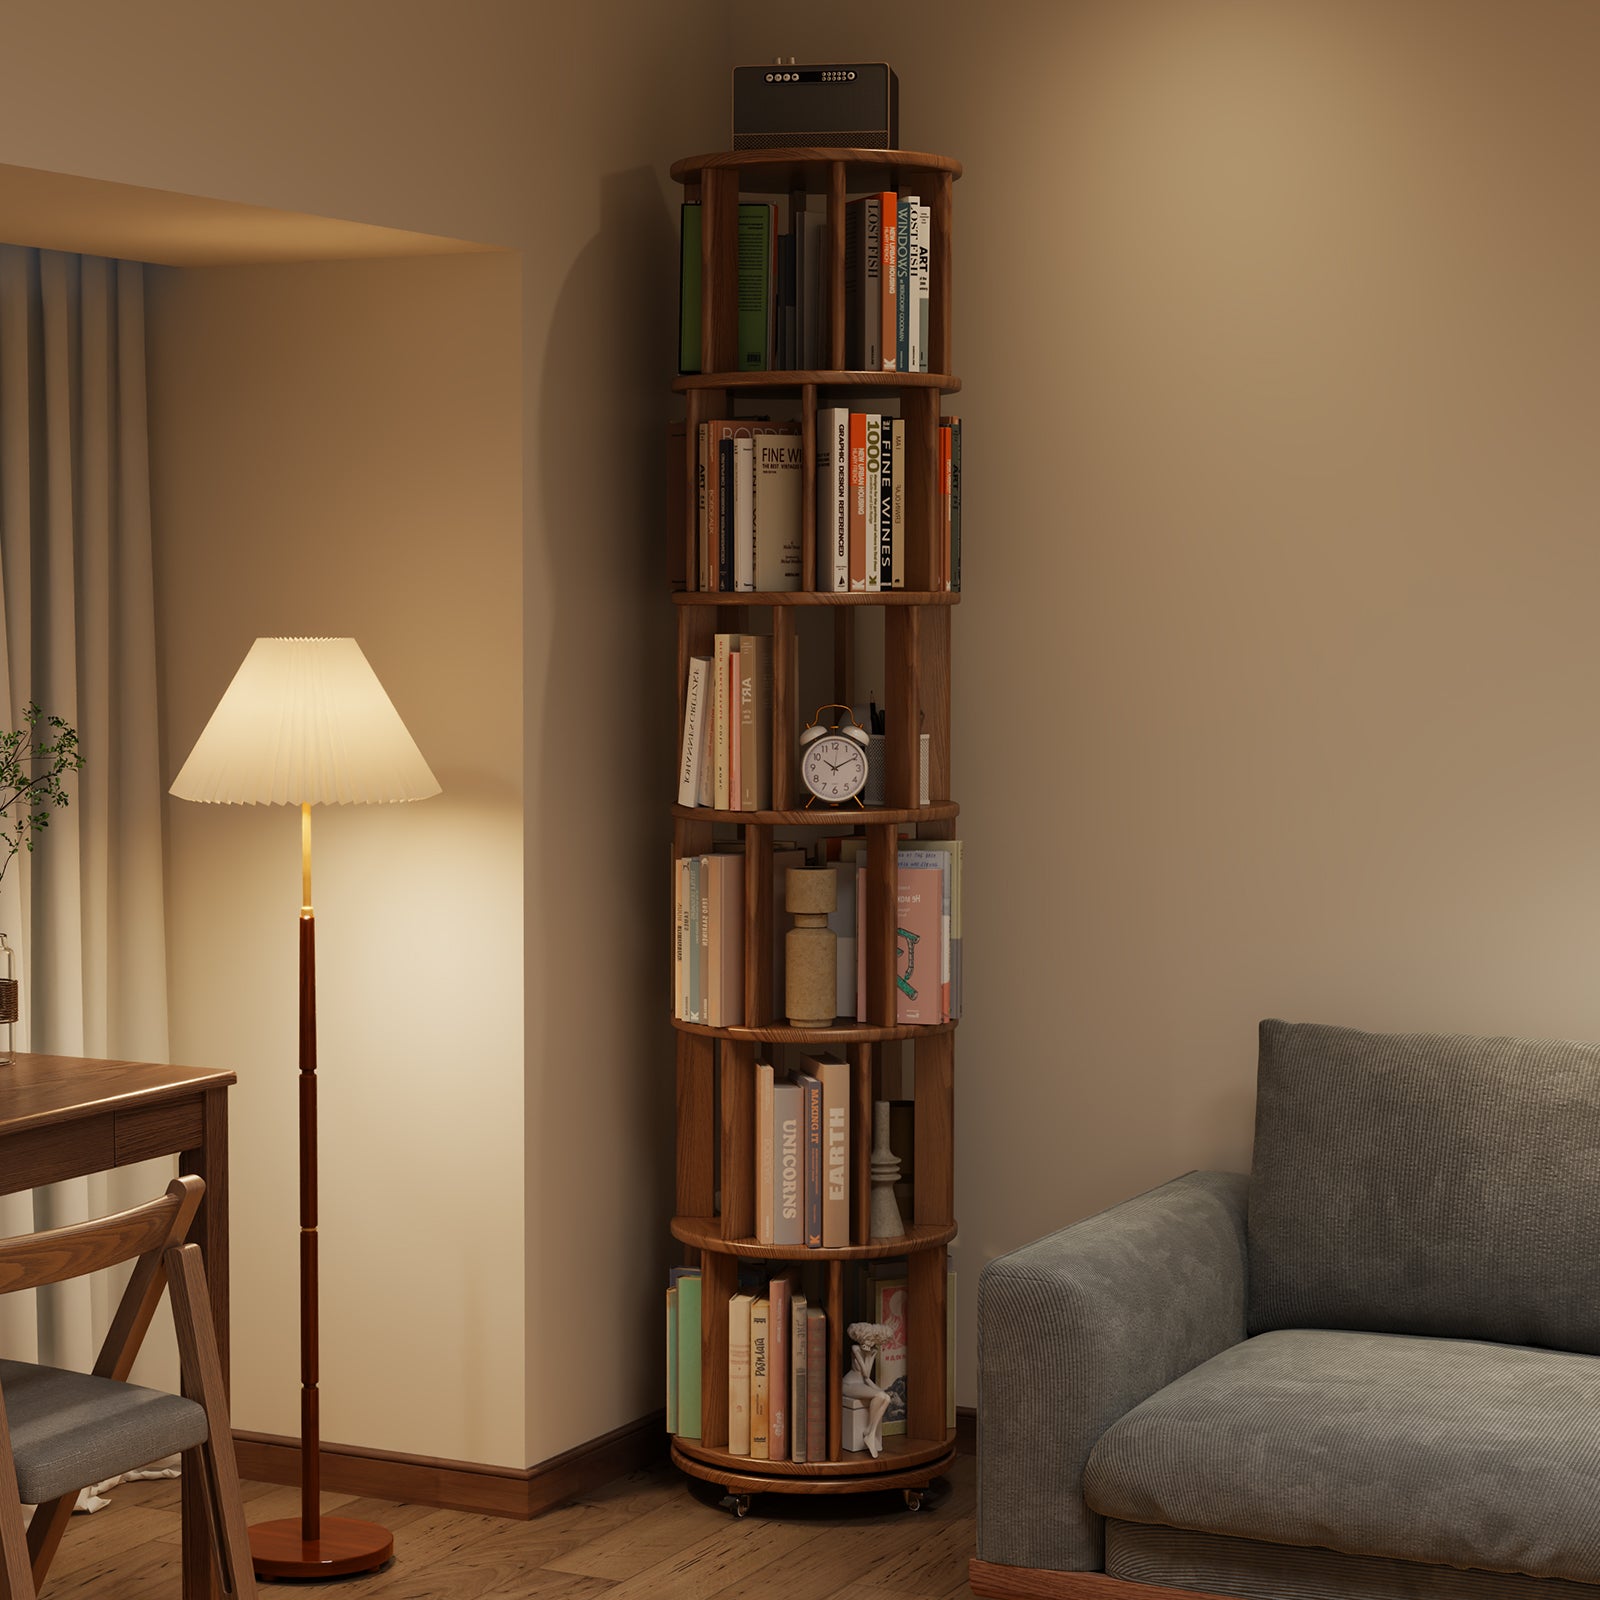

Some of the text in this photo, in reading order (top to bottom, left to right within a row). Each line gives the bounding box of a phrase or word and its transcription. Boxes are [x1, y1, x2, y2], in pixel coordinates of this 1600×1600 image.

[868, 205, 879, 278] LOST FISH
[897, 207, 908, 278] WINDOWS
[910, 202, 918, 277] LOST FISH
[919, 246, 928, 272] ART
[762, 447, 785, 463] FINE
[867, 421, 880, 473] 1000
[882, 440, 891, 487] FINE
[857, 447, 865, 515] NEW URBAN HOUSING
[882, 496, 891, 568] WINES
[821, 745, 828, 753] 11
[831, 742, 839, 751] 12
[813, 753, 821, 762] 10
[852, 752, 858, 761] 2
[810, 763, 816, 772] 9
[855, 764, 861, 773] 3
[813, 774, 819, 783] 8
[821, 782, 827, 791] 7
[832, 786, 838, 795] 6
[843, 783, 850, 792] 5
[811, 1088, 819, 1131] MAKING
[811, 1133, 819, 1144] IT
[829, 1107, 845, 1201] EARTH
[782, 1119, 797, 1219] UNICORNS
